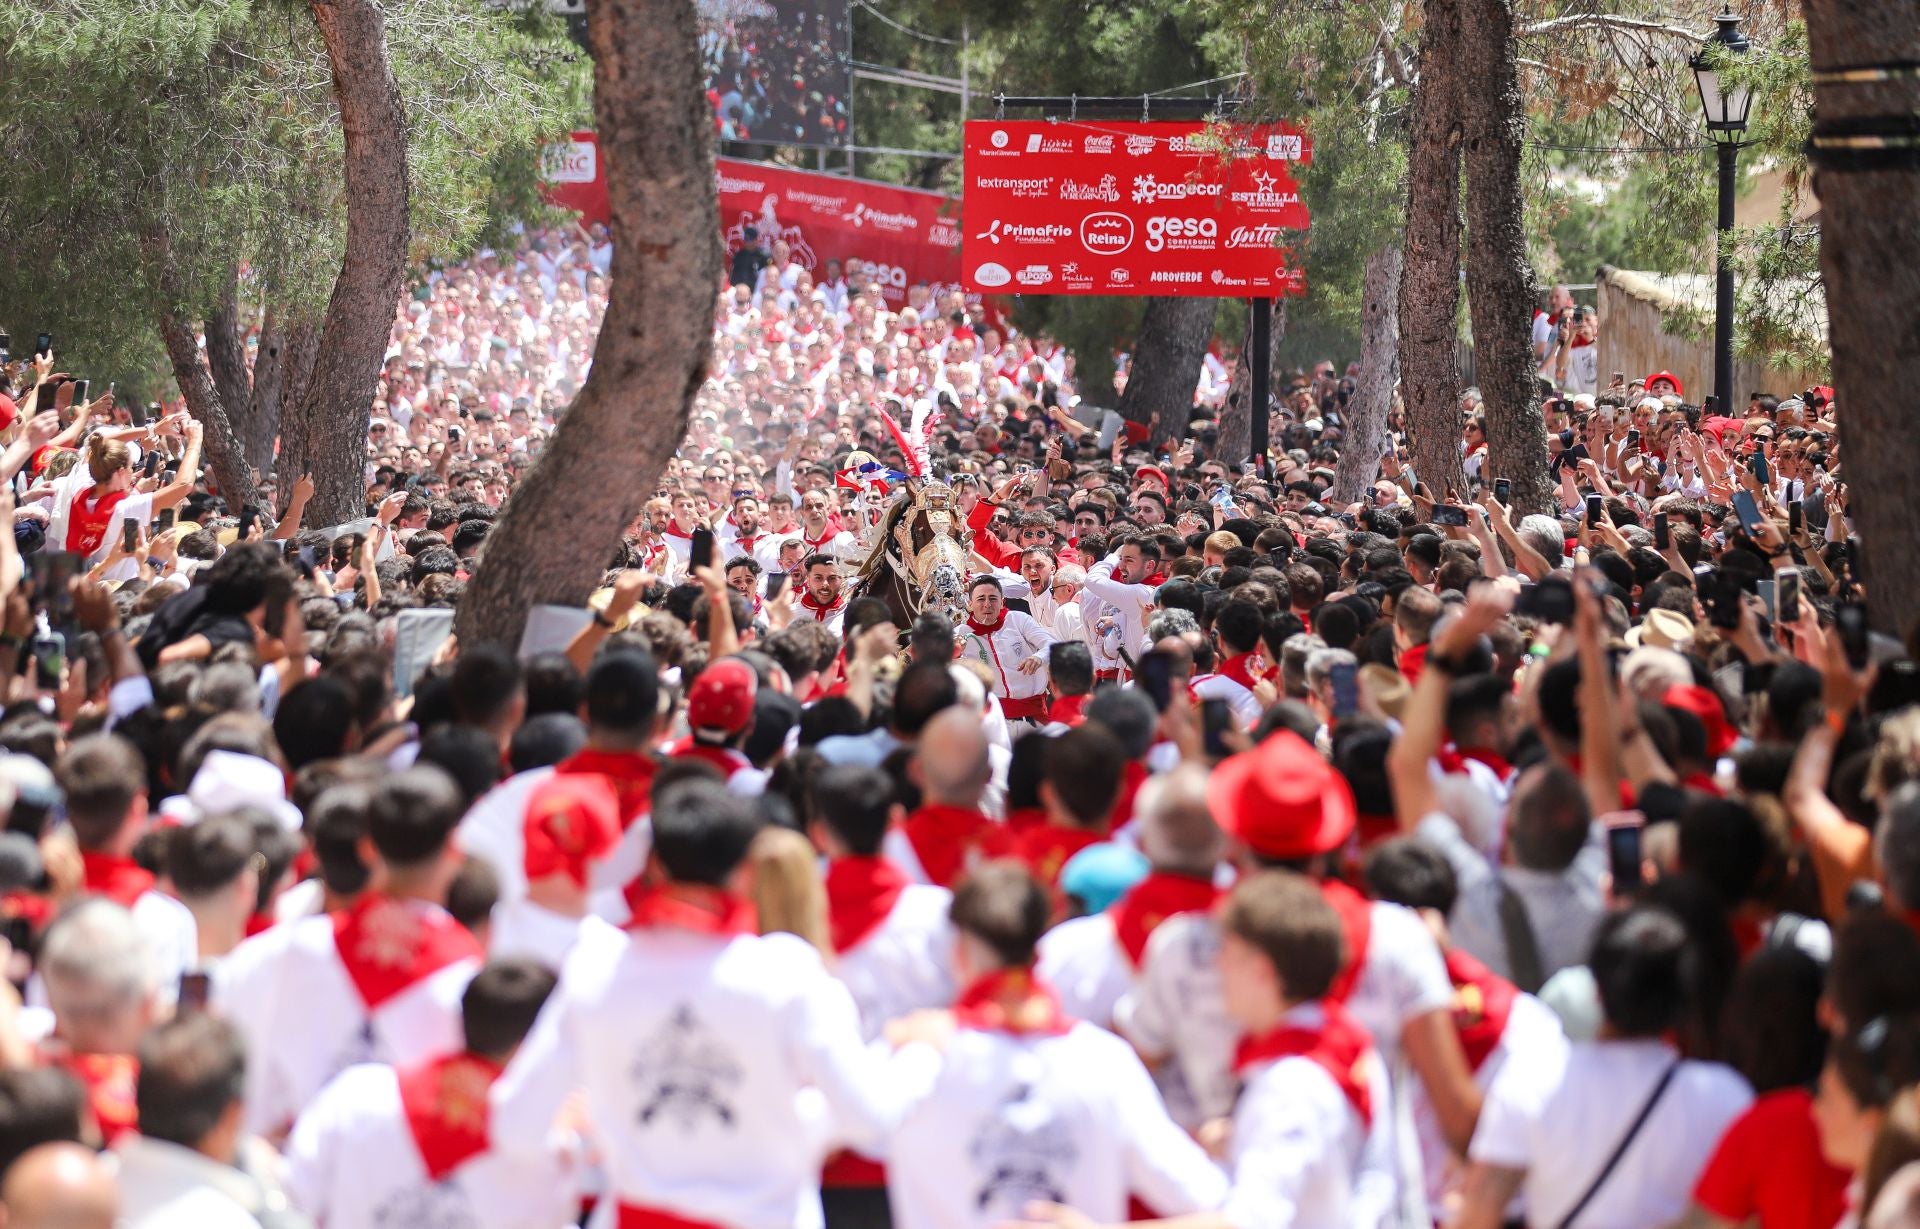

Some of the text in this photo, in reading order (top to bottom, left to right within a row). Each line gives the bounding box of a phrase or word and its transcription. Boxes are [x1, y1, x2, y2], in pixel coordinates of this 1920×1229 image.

[1142, 180, 1223, 200] Congecar
[1231, 192, 1298, 203] ESTRELLA
[1088, 233, 1126, 245] Reina
[1145, 216, 1218, 252] gesa
[1221, 277, 1247, 286] ribera
